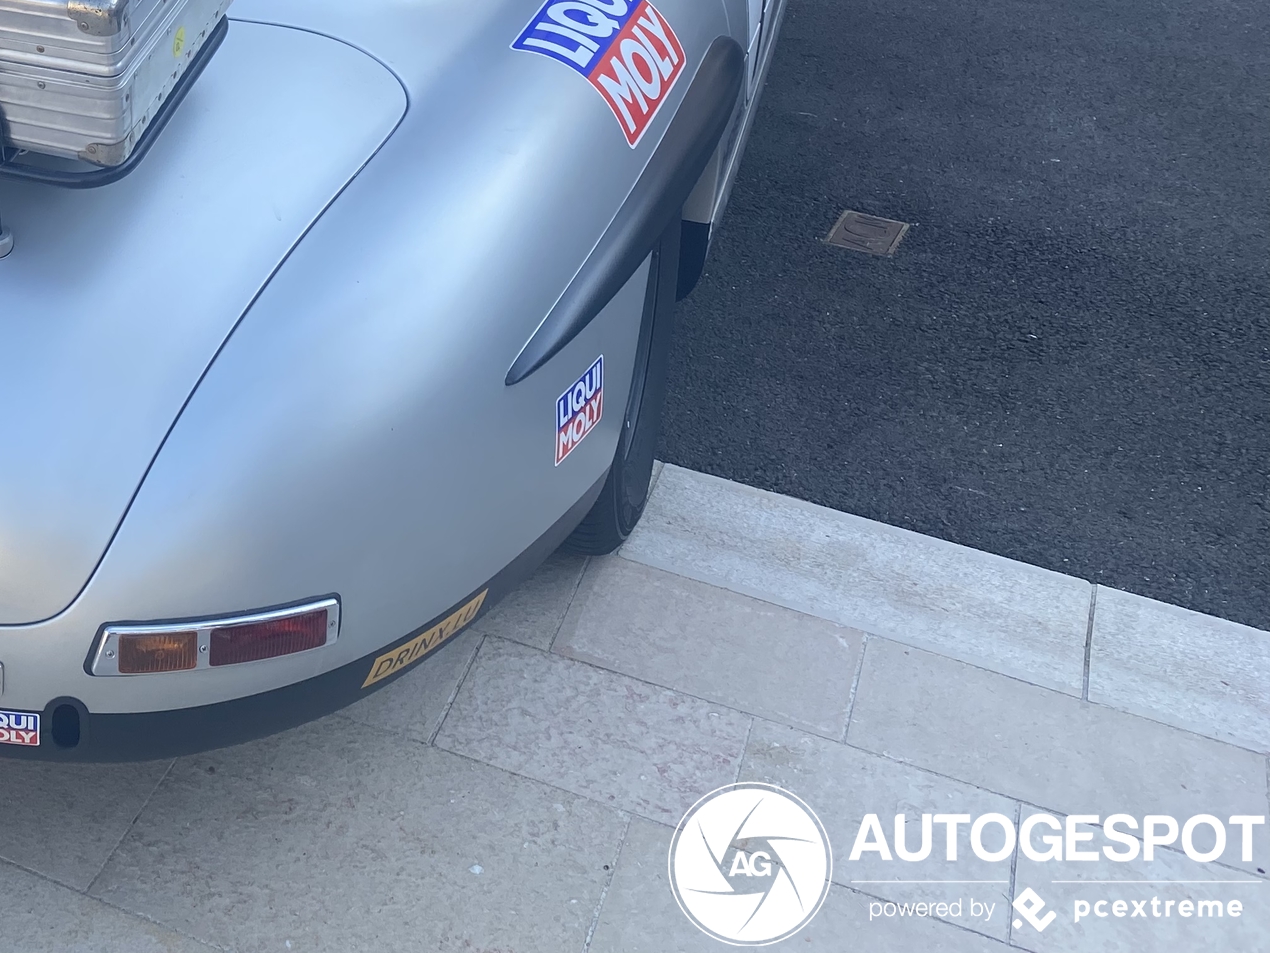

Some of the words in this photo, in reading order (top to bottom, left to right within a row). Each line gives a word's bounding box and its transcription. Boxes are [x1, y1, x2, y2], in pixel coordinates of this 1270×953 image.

[597, 5, 680, 135] MOLY
[558, 391, 601, 460] MOLY
[559, 361, 601, 428] LIQUI
